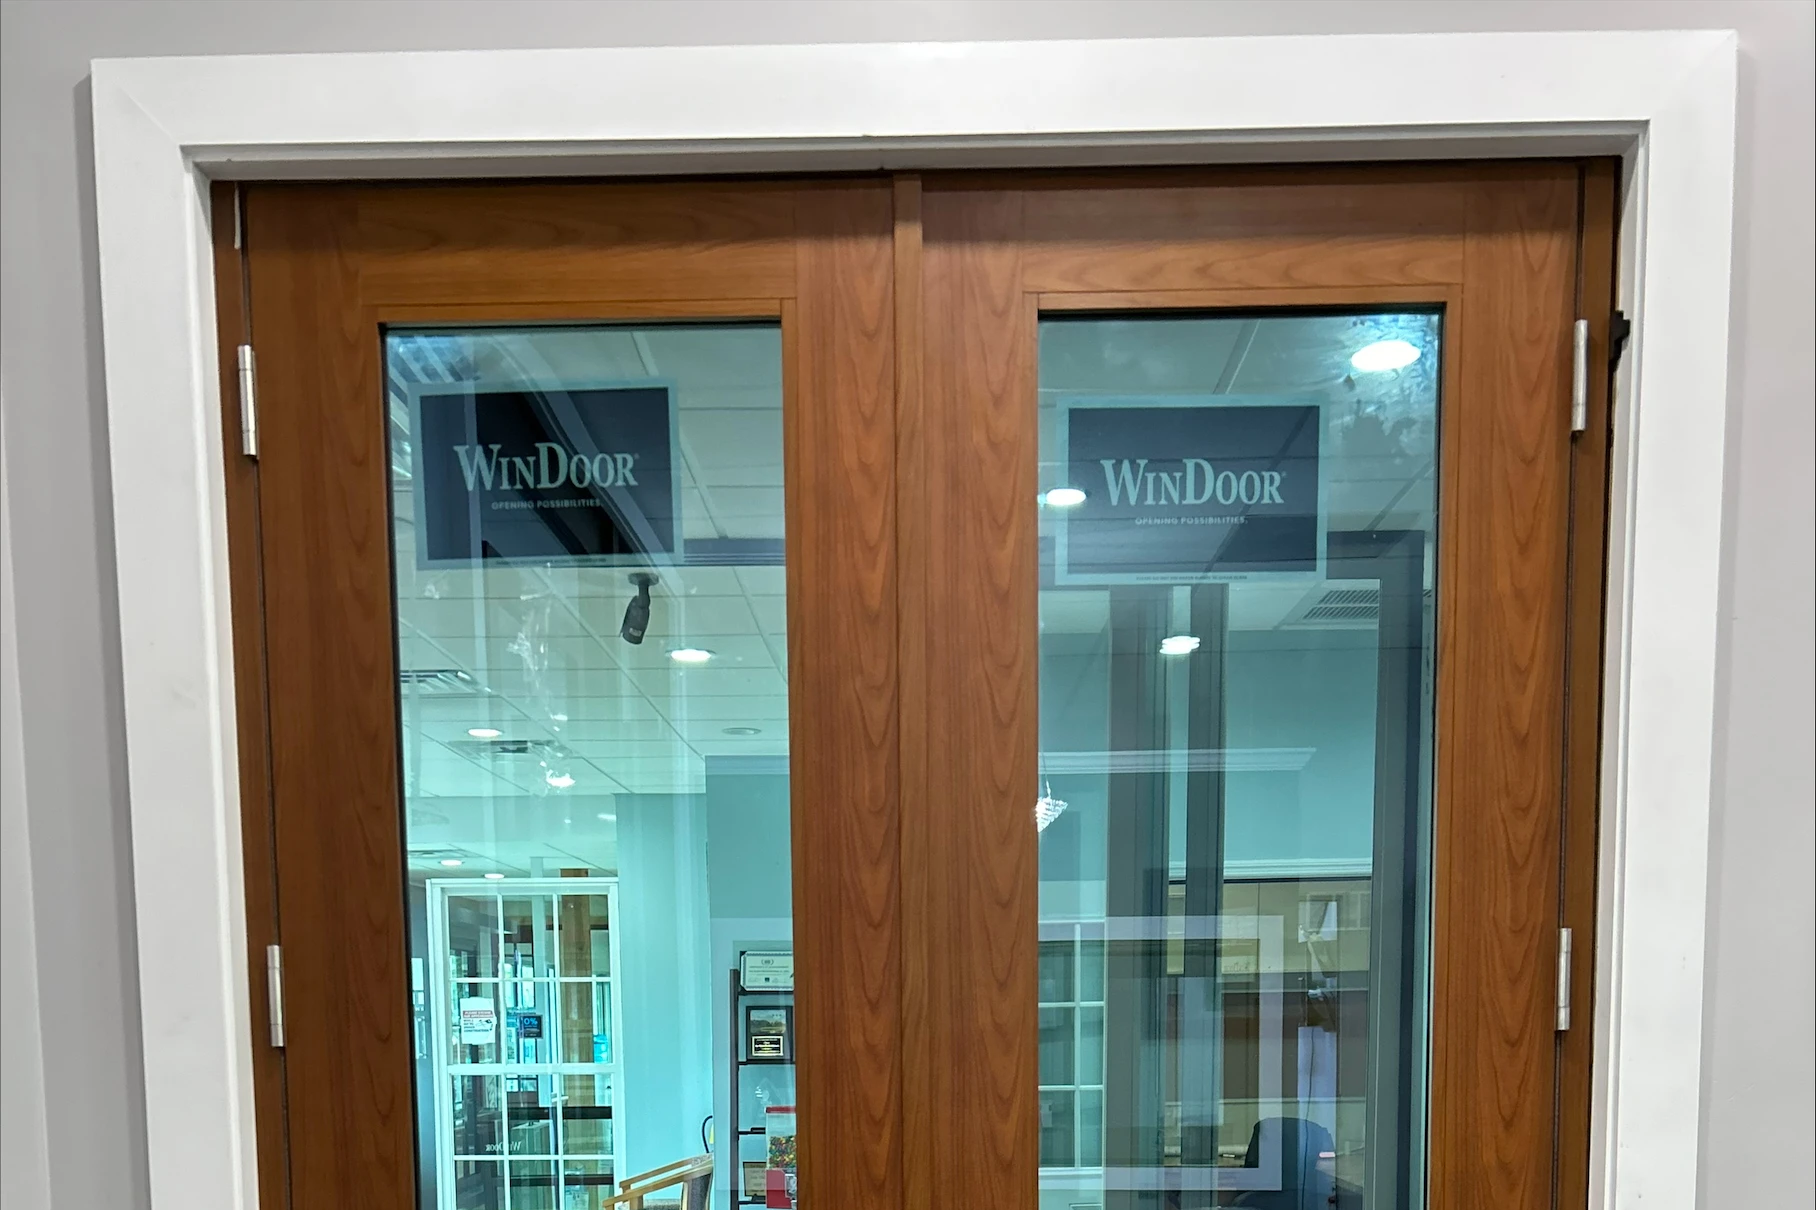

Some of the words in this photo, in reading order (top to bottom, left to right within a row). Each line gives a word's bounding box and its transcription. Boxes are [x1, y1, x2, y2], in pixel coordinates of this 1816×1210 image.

[491, 501, 535, 511] OPENING
[1134, 517, 1179, 526] OPENING
[523, 1017, 538, 1025] 0%
